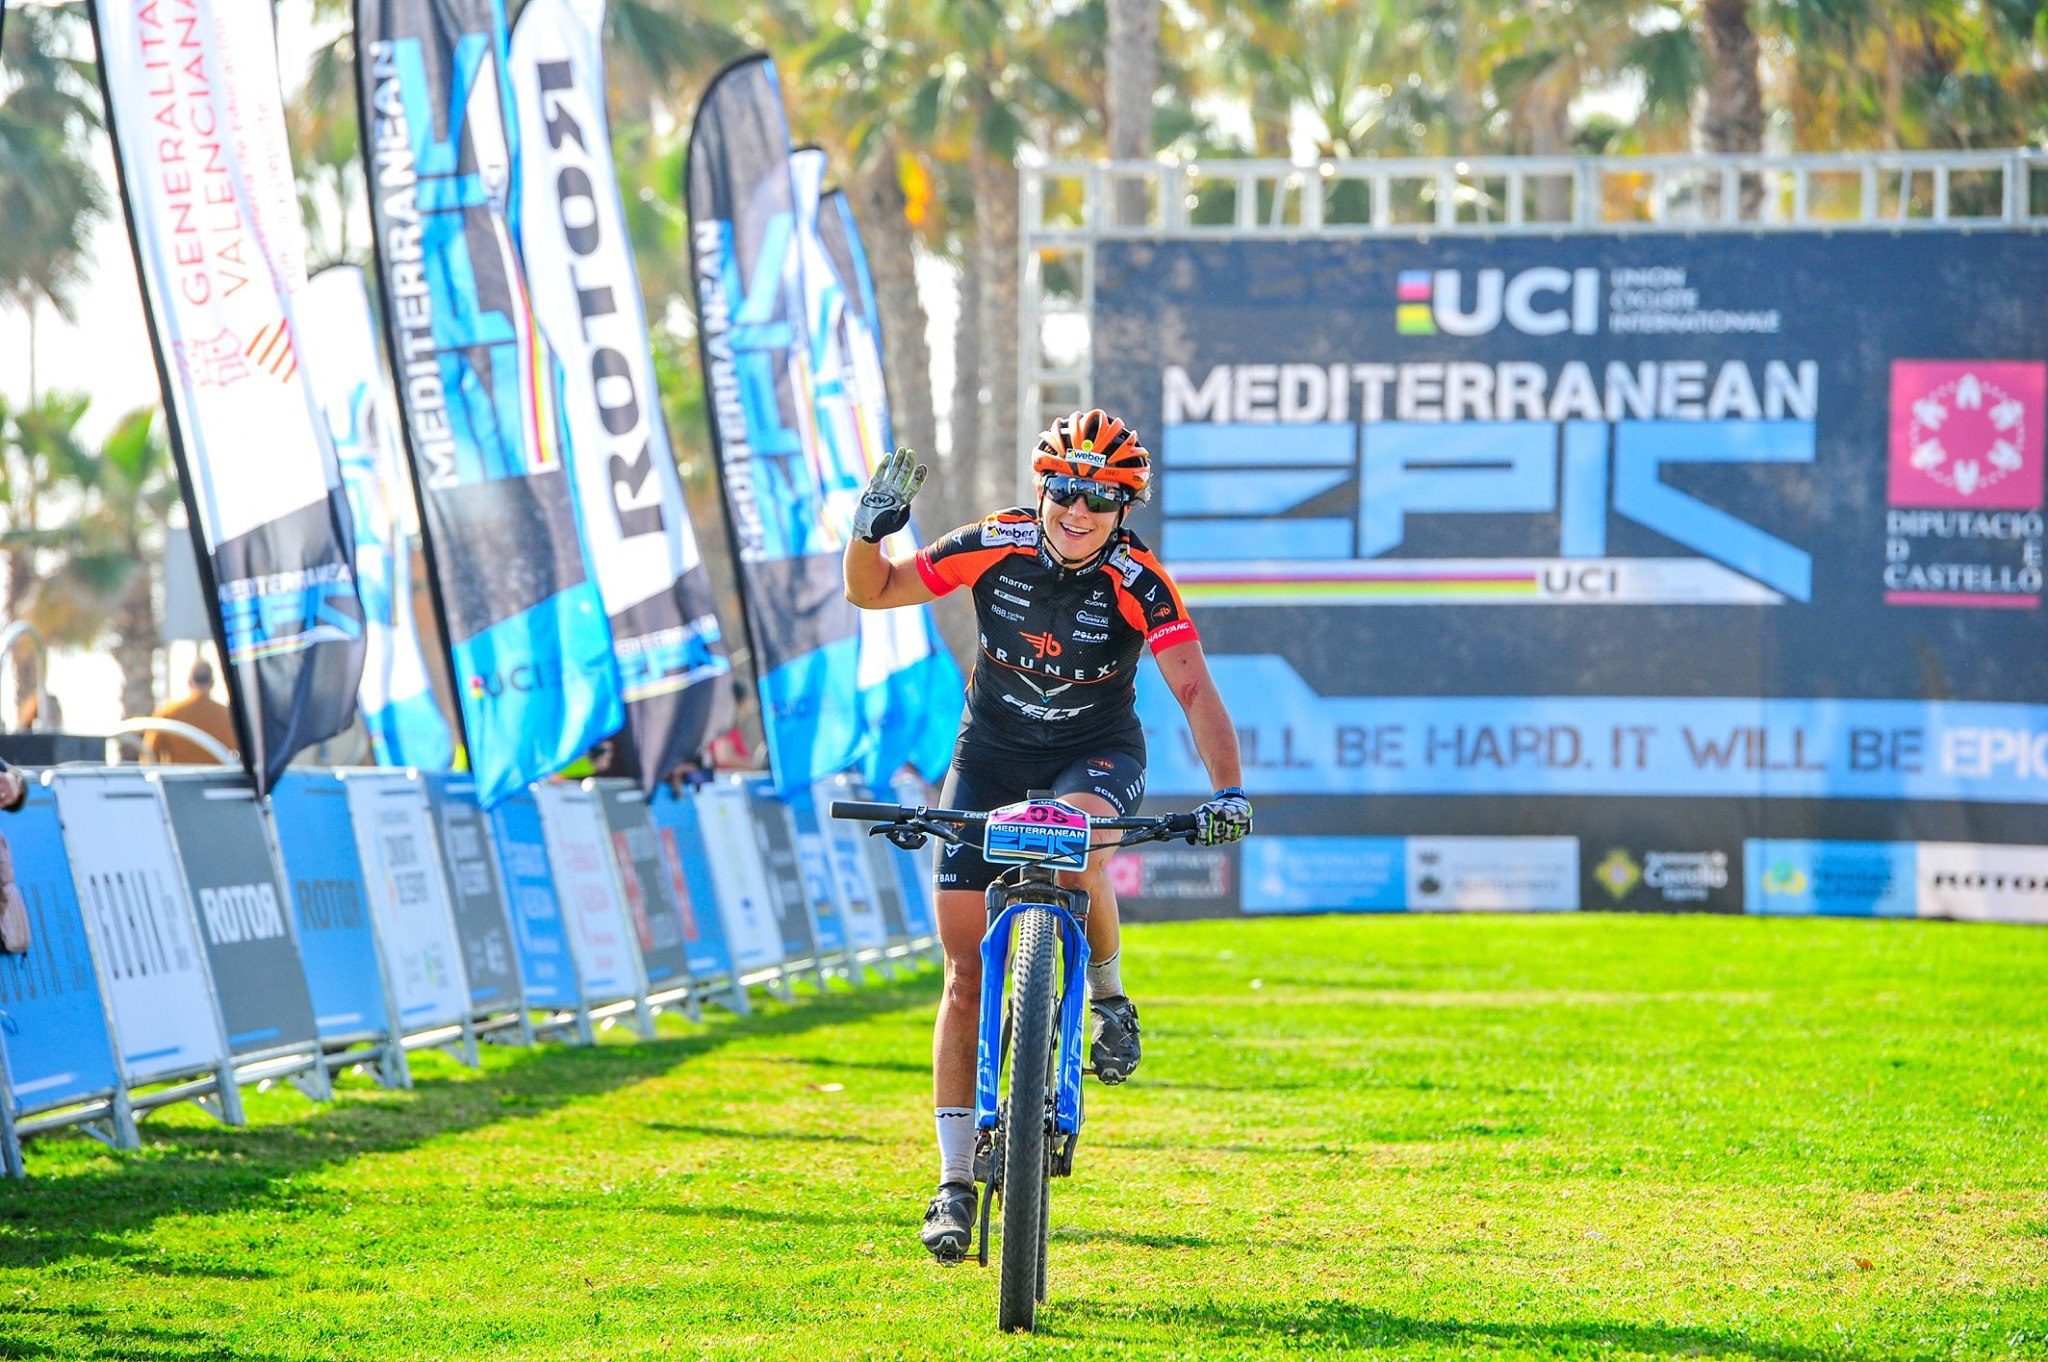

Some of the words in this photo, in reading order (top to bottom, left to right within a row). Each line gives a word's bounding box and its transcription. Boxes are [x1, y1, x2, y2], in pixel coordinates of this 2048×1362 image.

[136, 0, 212, 306] GENERALITA
[368, 40, 459, 490] MEDITERRANEAN
[1611, 267, 1687, 289] UNION
[537, 60, 668, 539] ROTOR
[1434, 267, 1600, 336] UCI
[1609, 310, 1780, 334] INTERNATIONALE
[1163, 361, 1818, 424] MEDITERRANEAN
[1162, 421, 1816, 603] EPIC
[1886, 537, 1911, 563] D
[999, 575, 1034, 592] marrer
[1544, 568, 1618, 595] UCI
[1072, 630, 1109, 641] POLAR
[980, 633, 1110, 681] BRUNEX
[484, 662, 543, 698] UCI
[1001, 693, 1095, 721] FELT
[1335, 725, 1405, 769] BE
[1425, 725, 1592, 770] HARD.
[1611, 725, 1657, 770] IT
[1682, 725, 1827, 771] WILL
[1848, 726, 1923, 772] BE
[991, 825, 1085, 839] MEDITERRANEAN
[940, 873, 957, 883] BAU
[1934, 871, 2048, 893] ROTO
[199, 881, 286, 947] ROTOR
